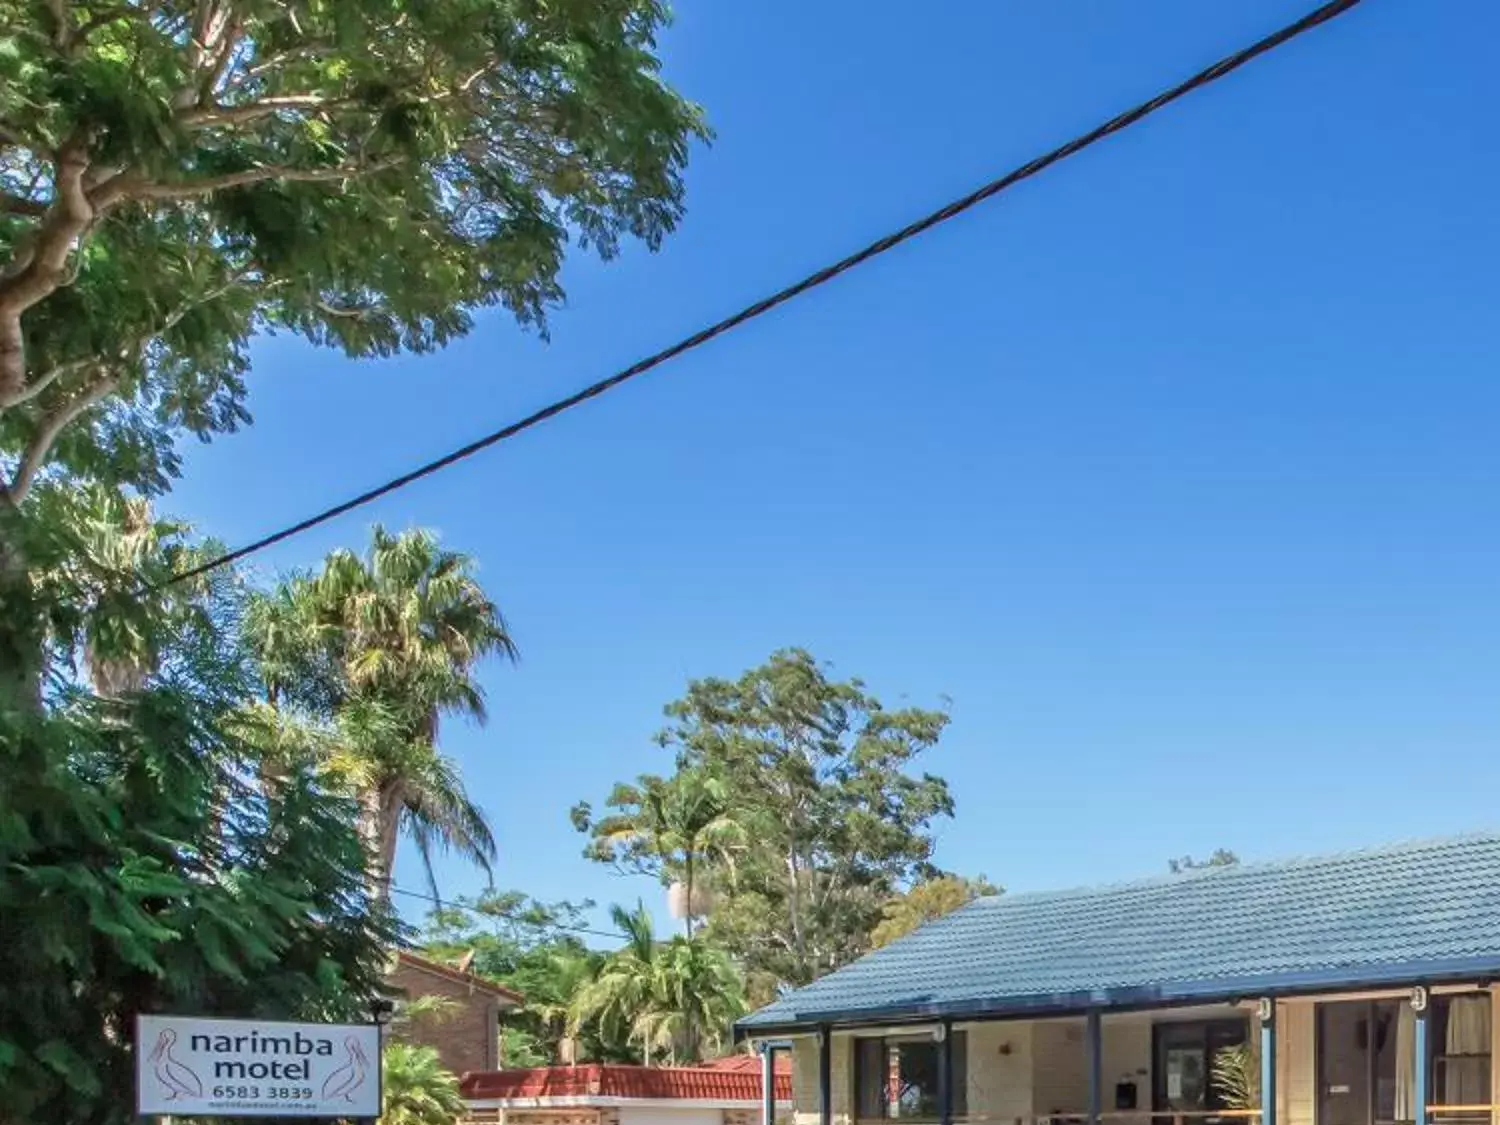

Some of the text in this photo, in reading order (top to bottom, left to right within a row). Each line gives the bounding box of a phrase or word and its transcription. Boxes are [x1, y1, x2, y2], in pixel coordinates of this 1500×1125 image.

[191, 1031, 333, 1055] narimba
[215, 1059, 310, 1080] motel
[213, 1085, 313, 1099] 6583 3839
